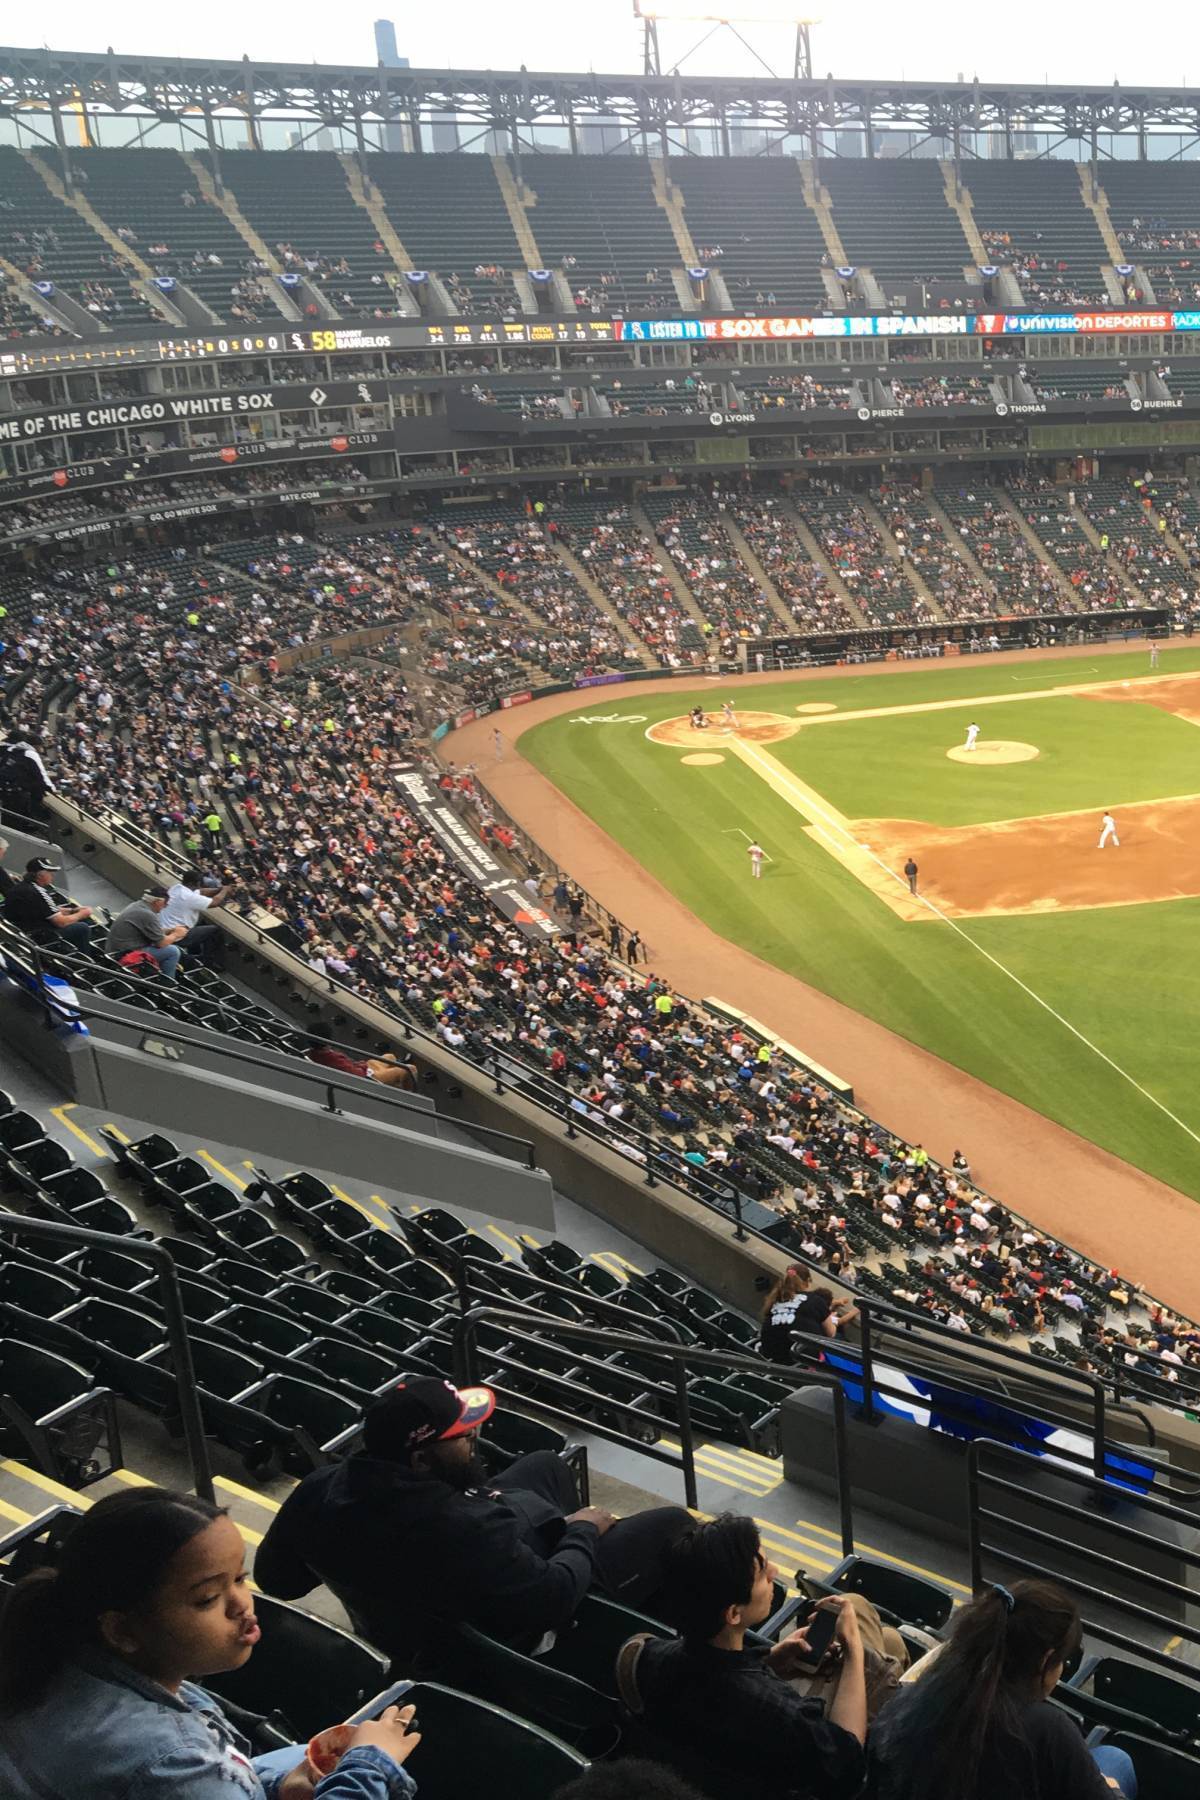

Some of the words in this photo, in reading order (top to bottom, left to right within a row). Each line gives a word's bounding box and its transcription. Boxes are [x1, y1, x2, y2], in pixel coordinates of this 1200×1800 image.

[650, 321, 682, 338] LISTEN
[721, 320, 767, 337] SOX
[768, 318, 847, 338] GAMES
[850, 317, 873, 336] IN
[877, 316, 967, 334] SPANISH
[1095, 315, 1166, 329] DEPORTES
[218, 340, 228, 353] 0
[243, 338, 253, 351] 0
[268, 337, 278, 350] 0
[312, 331, 335, 350] 58
[1010, 404, 1046, 413] THOMAS
[1144, 400, 1183, 409] BUEHRLE
[24, 418, 45, 434] OF
[48, 412, 82, 430] THE
[87, 403, 165, 425] CHICAGO
[170, 397, 232, 416] WHITE
[238, 393, 274, 411] SOX
[725, 413, 755, 424] LYONS
[872, 409, 904, 418] PIERCE
[349, 434, 378, 446] CLUB
[237, 444, 265, 456] CLUB
[67, 467, 95, 478] CLUB
[177, 506, 200, 517] WHITE
